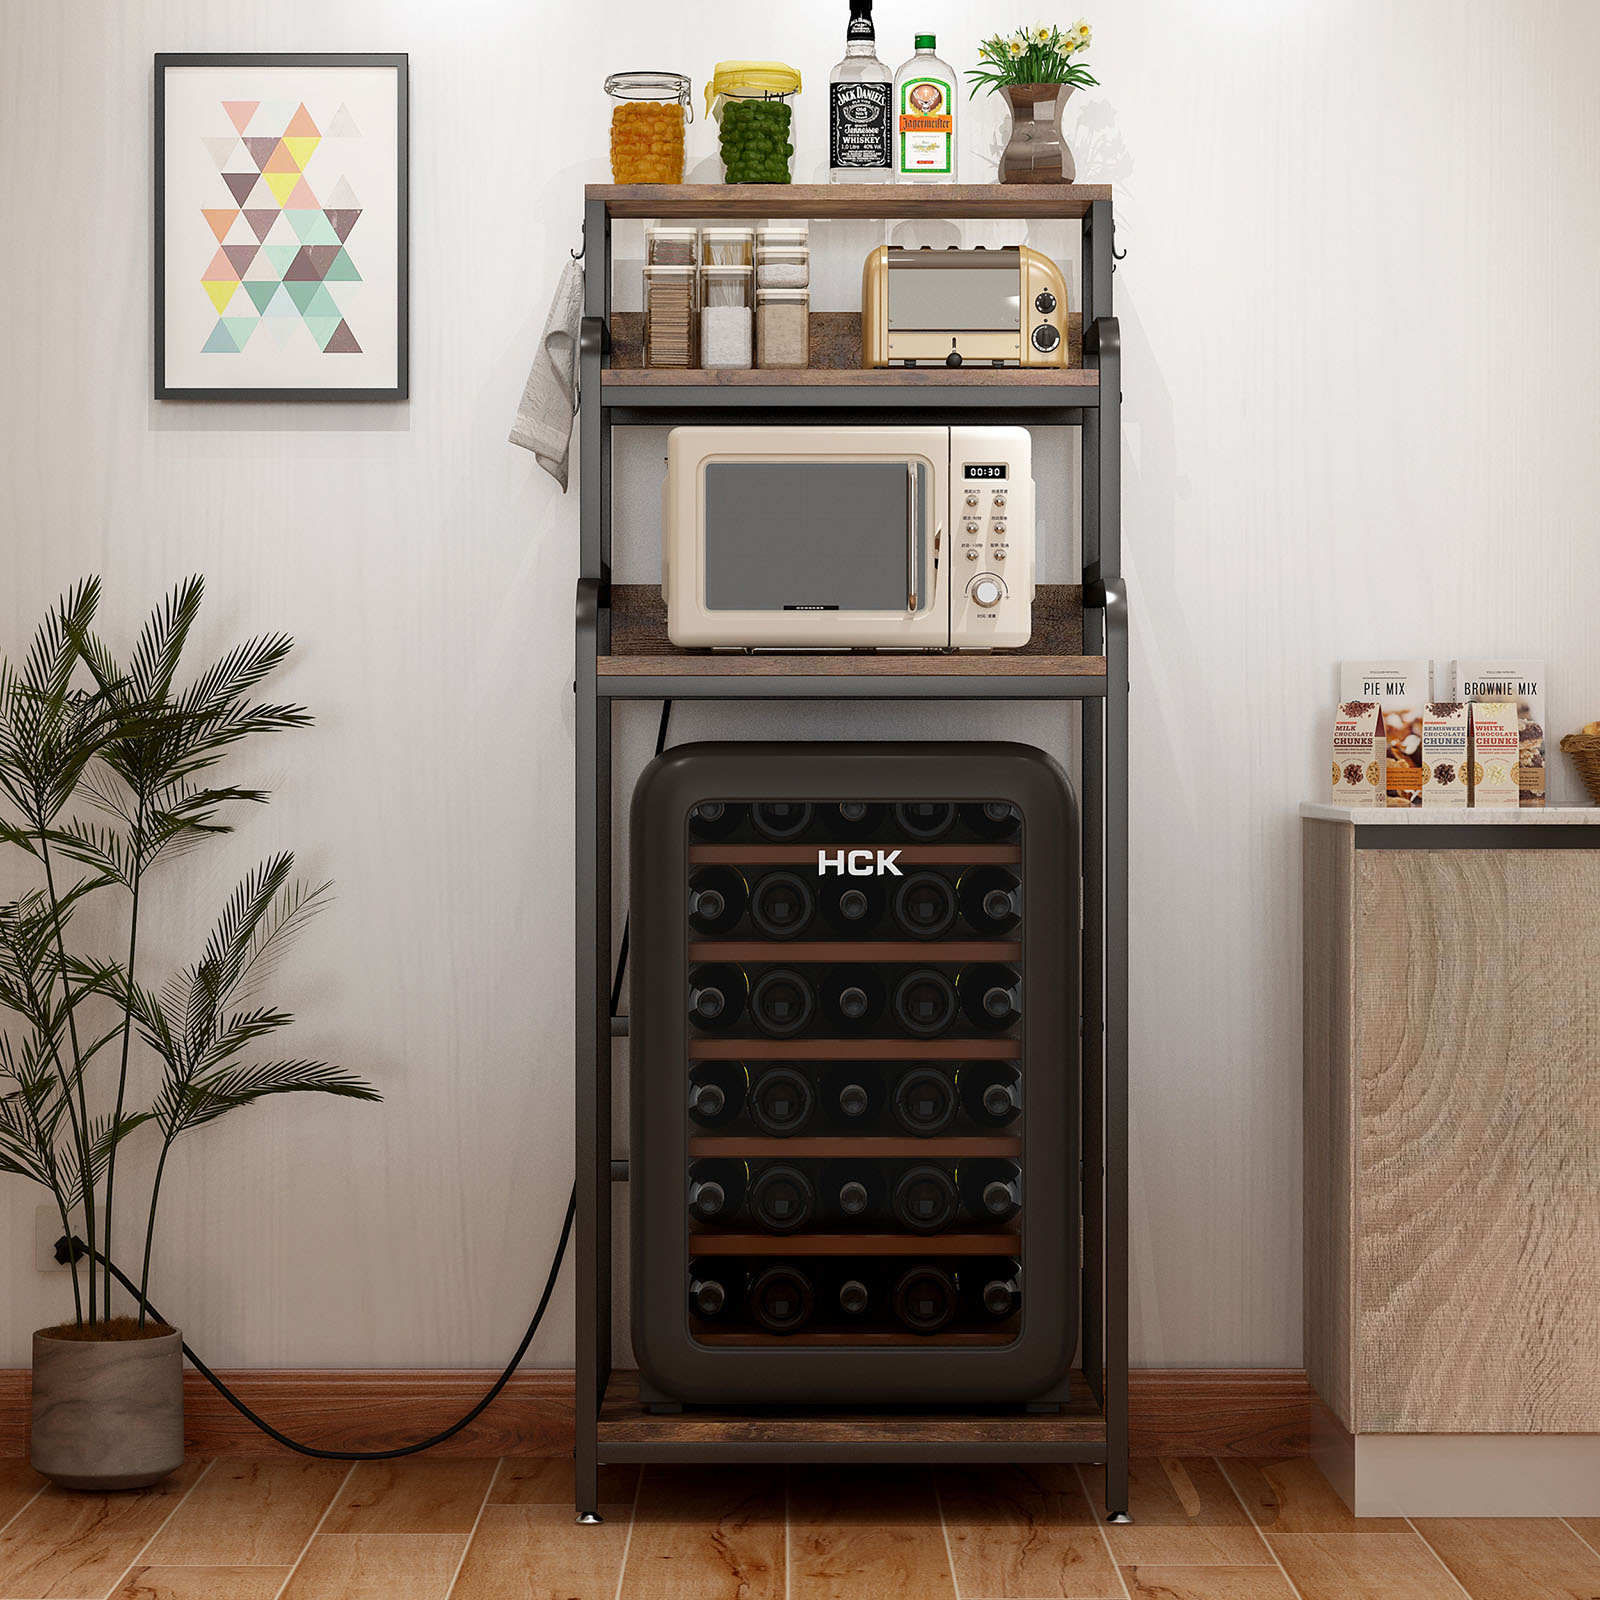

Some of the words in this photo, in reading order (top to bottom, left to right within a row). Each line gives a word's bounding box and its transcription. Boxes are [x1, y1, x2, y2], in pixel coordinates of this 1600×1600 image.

[837, 89, 857, 106] JACK
[844, 123, 879, 134] Tennessee
[842, 136, 881, 144] WHISKEY
[970, 467, 1001, 477] 00:30
[1364, 682, 1381, 696] PIE
[1386, 682, 1405, 696] MIX
[1464, 682, 1513, 696] BROWNIE
[1518, 682, 1537, 696] MIX
[818, 849, 904, 876] HCK
